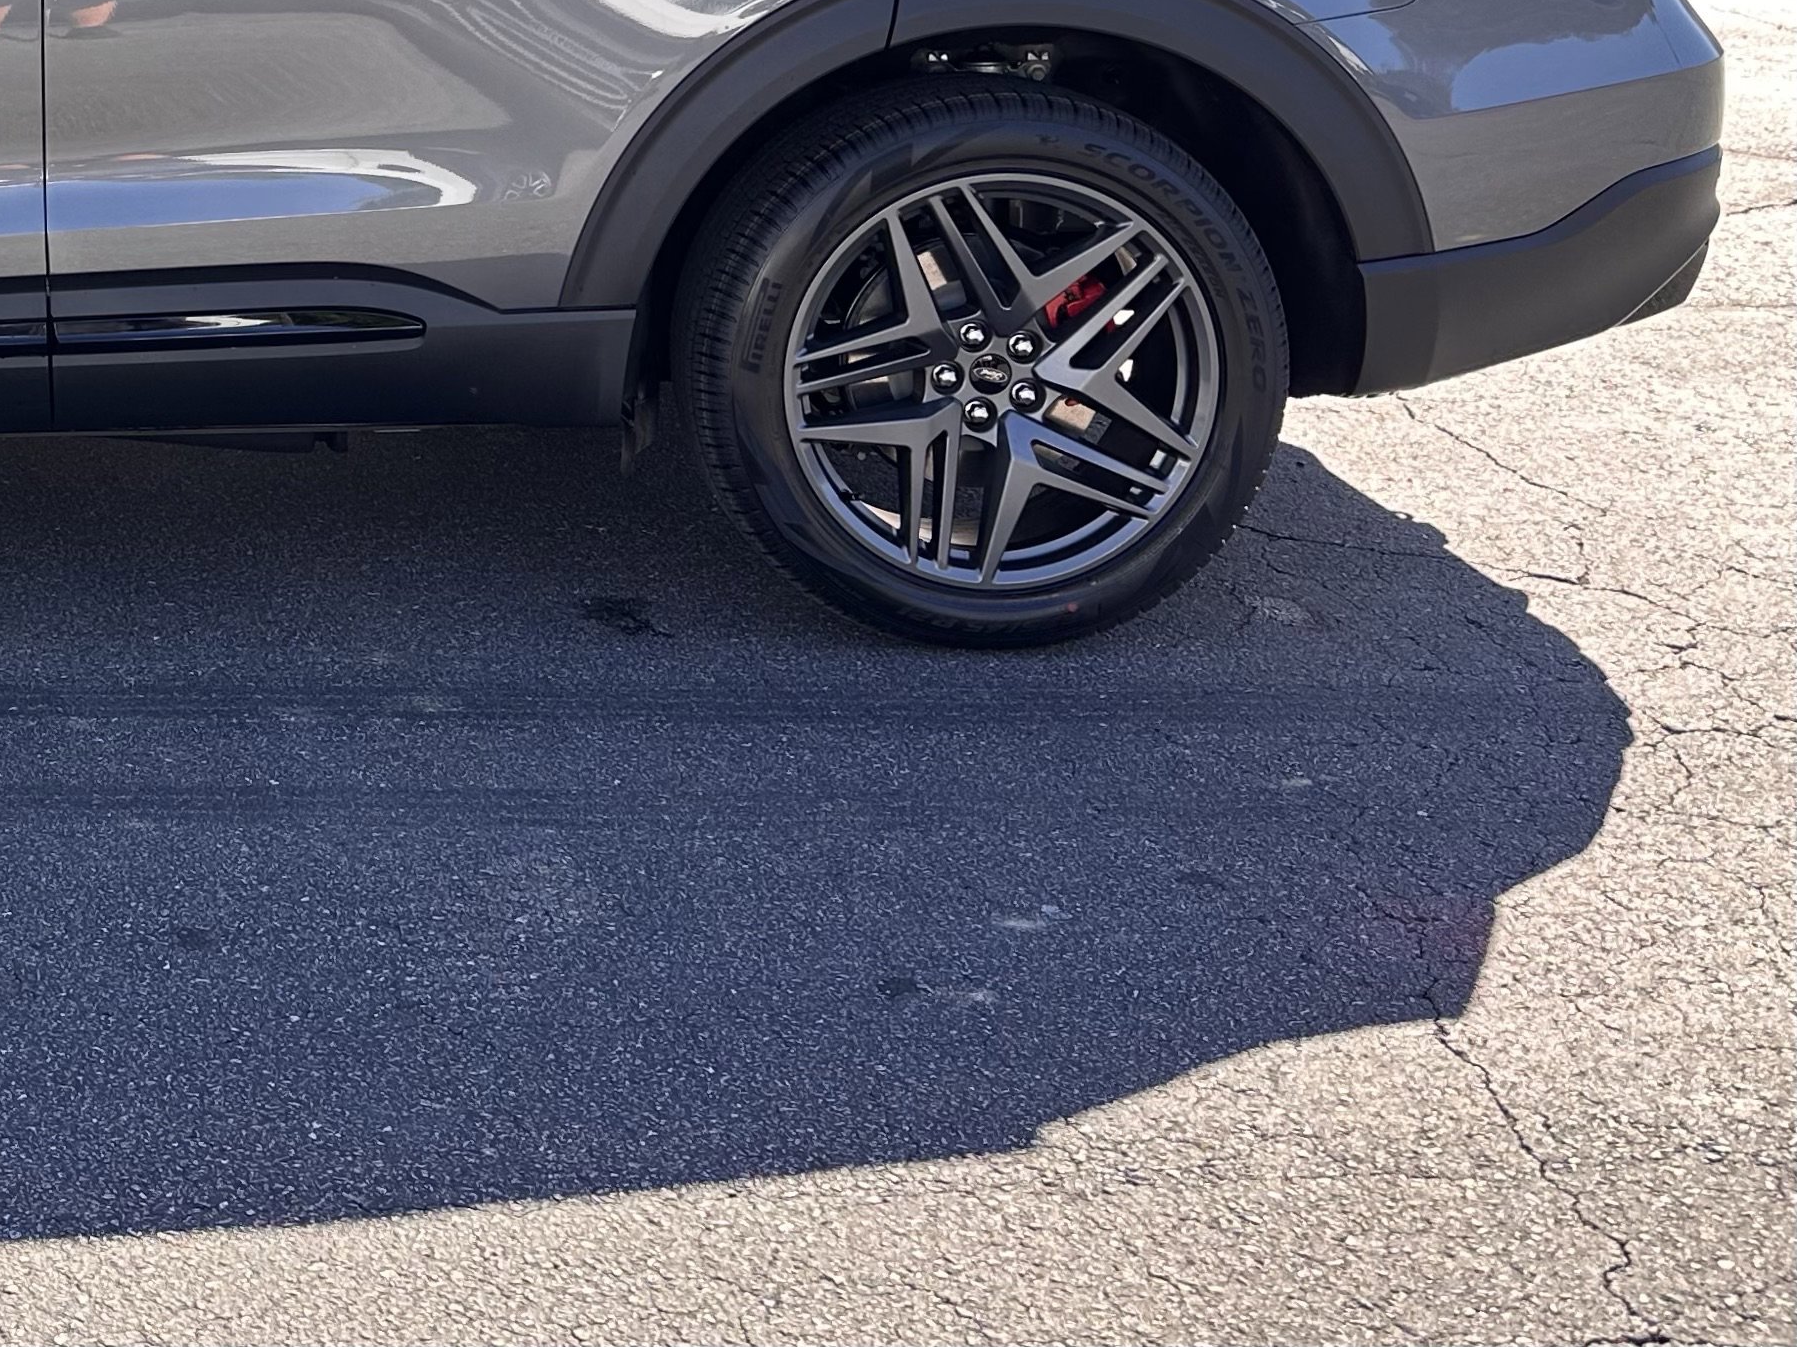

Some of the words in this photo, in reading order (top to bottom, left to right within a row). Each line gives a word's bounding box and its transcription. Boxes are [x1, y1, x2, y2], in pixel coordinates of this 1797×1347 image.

[738, 276, 783, 374] PIRELLI
[1076, 142, 1244, 273] SCORPION
[1235, 287, 1267, 393] ZERO
